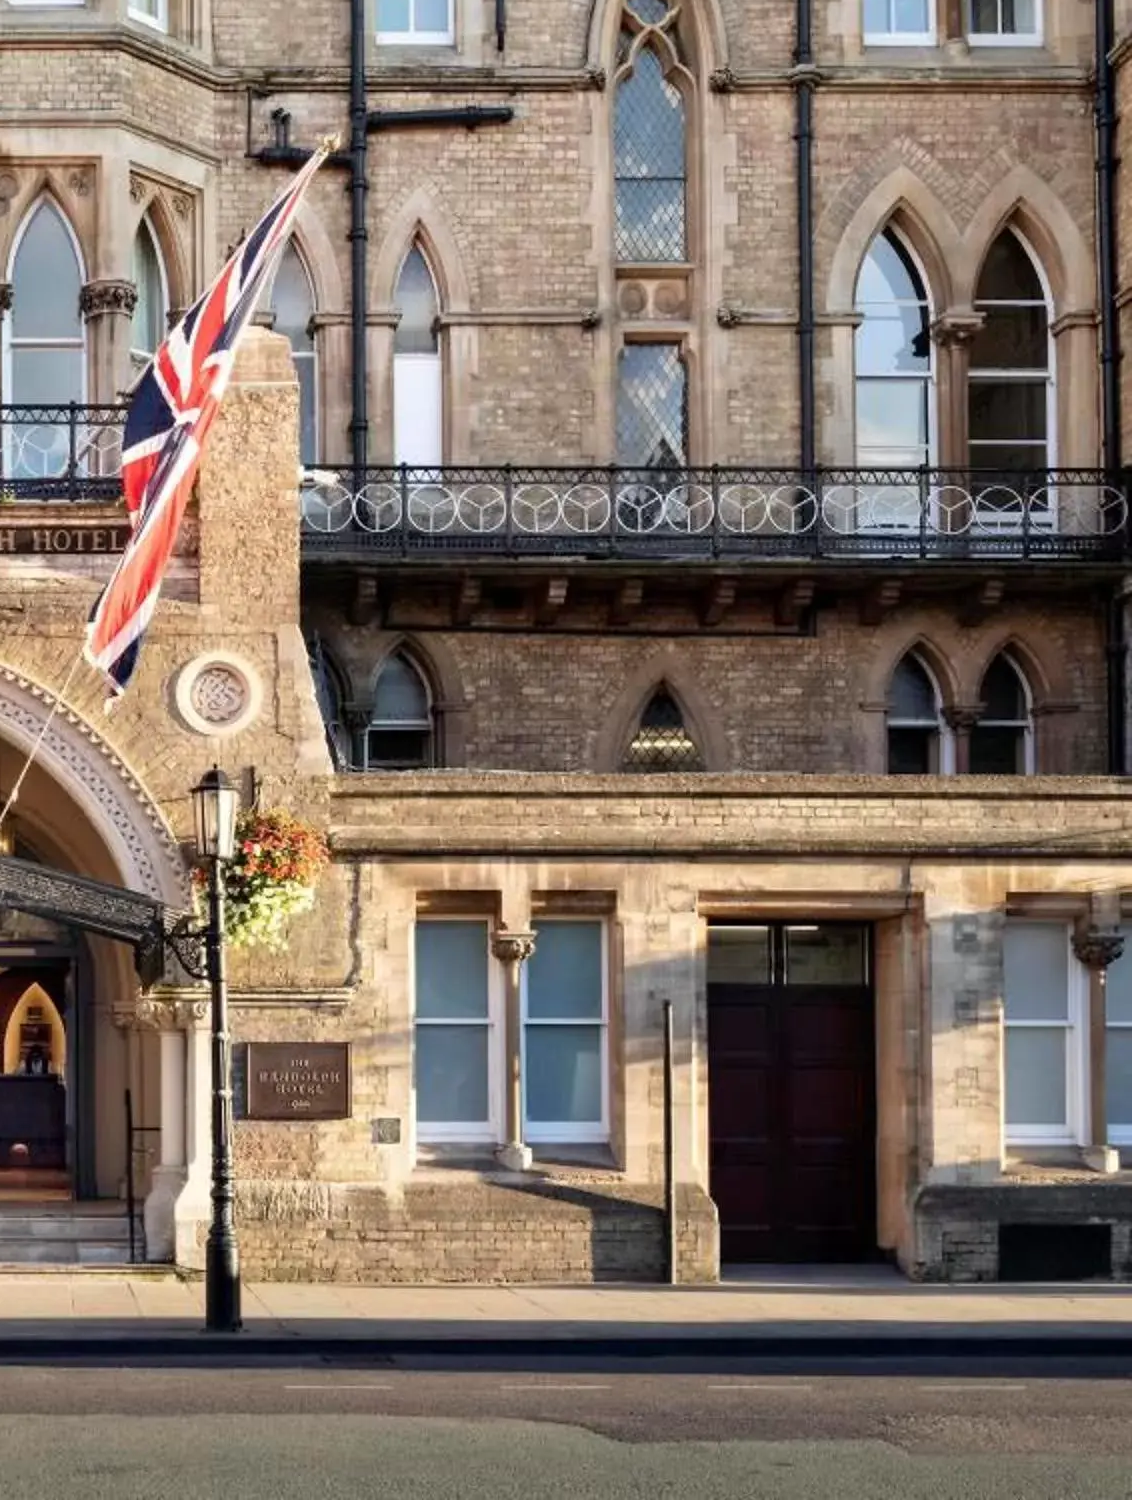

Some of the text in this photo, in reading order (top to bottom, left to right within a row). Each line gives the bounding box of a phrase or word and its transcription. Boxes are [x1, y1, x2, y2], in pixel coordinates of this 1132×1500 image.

[34, 529, 125, 551] HOTEL
[259, 1071, 341, 1083] RANDOLPH
[276, 1083, 325, 1095] HOTEL
